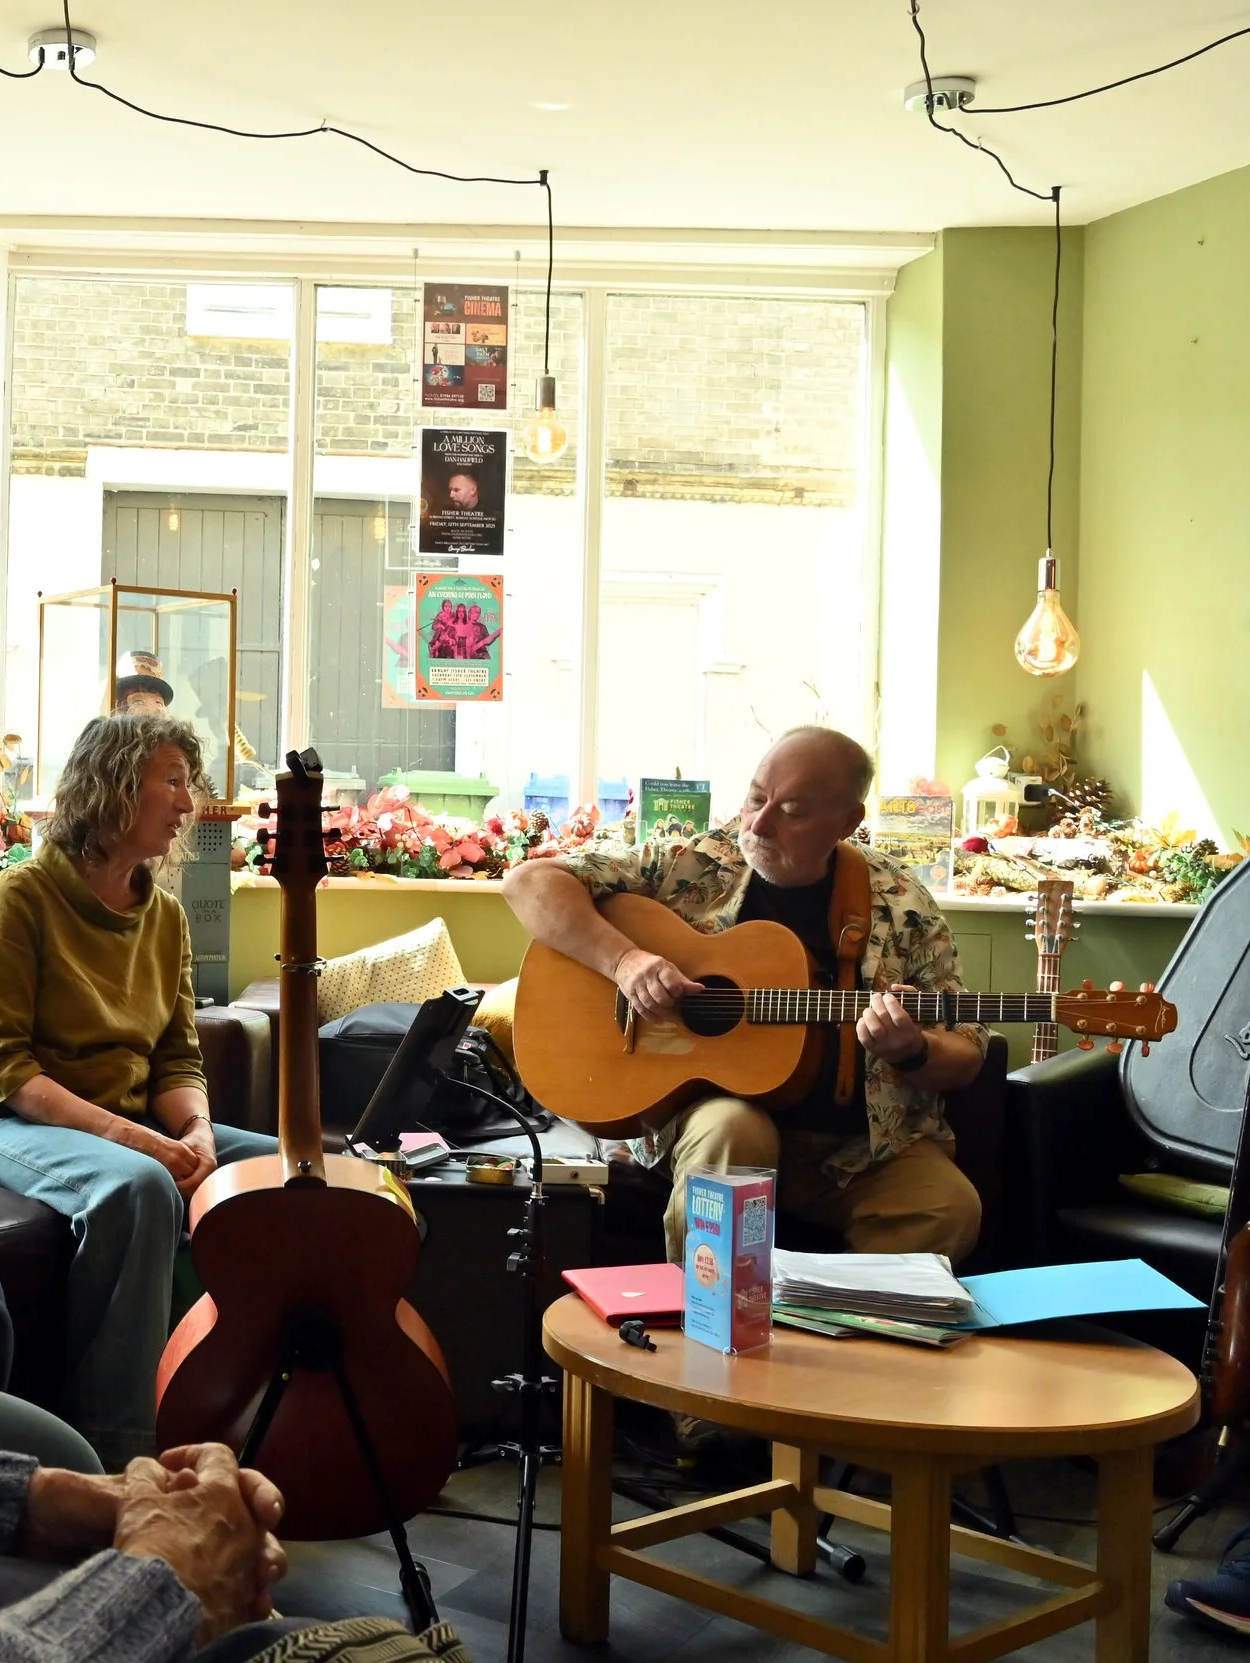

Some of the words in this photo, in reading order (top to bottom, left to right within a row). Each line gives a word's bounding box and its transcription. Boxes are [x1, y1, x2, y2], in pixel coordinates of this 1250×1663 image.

[464, 301, 502, 317] CINEMA
[443, 435, 450, 443] A
[451, 435, 485, 444] MILLION
[433, 442, 460, 452] LOVE
[461, 444, 495, 454] SONGS
[191, 899, 226, 909] QUOTE
[195, 913, 223, 923] BOX
[692, 1185, 707, 1197] FISHER
[707, 1189, 725, 1202] THEATRE
[692, 1195, 725, 1222] LOTTERY
